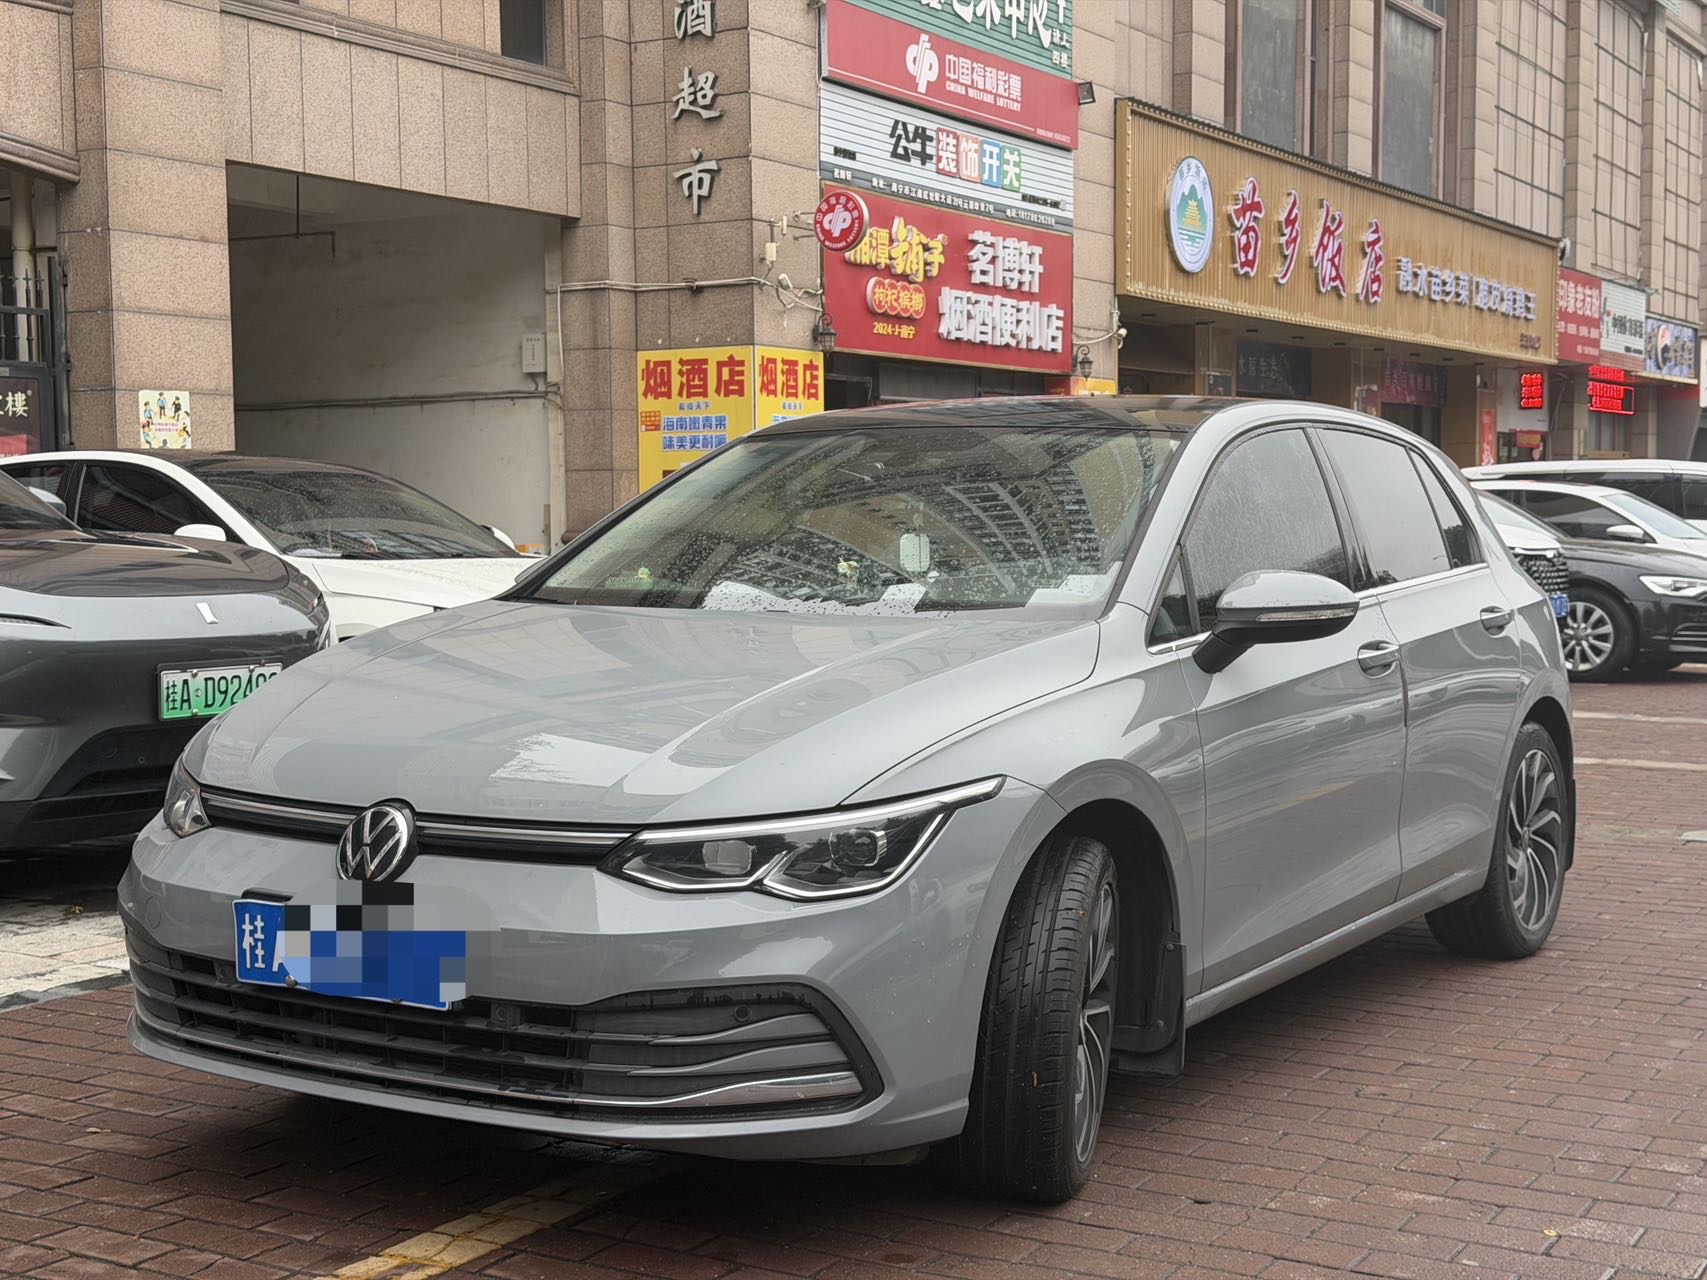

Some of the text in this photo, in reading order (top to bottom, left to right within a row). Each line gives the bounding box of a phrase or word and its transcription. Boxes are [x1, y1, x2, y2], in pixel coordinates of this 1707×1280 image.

[945, 54, 1022, 101] 中国福利彩票
[945, 81, 1022, 112] CHINA WELFARE LOTTERY
[671, 0, 725, 216] 酒超市
[968, 230, 1044, 293] 茗博轩
[1231, 177, 1383, 304] 苗乡饭店
[937, 286, 1064, 352] 烟酒便利店
[642, 354, 745, 400] 烟酒店
[759, 355, 820, 401] 烟酒店
[0, 390, 29, 418] 樓
